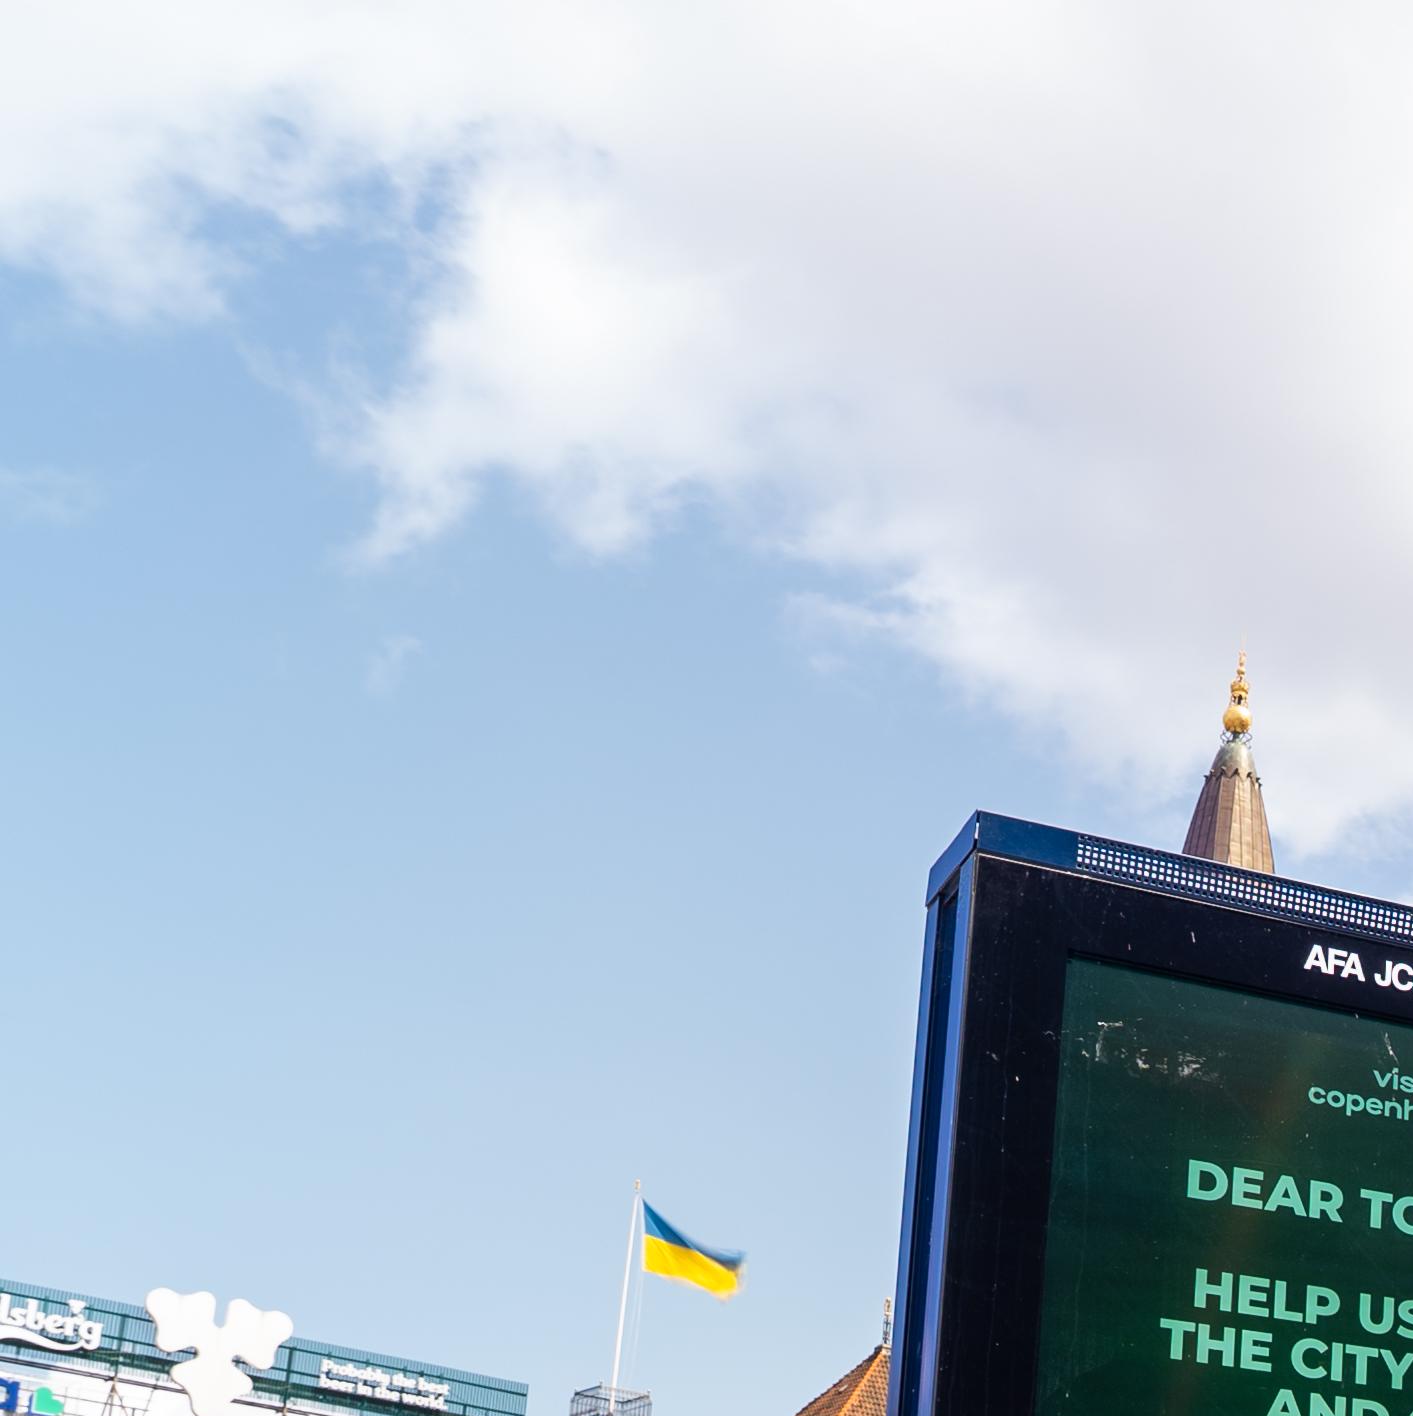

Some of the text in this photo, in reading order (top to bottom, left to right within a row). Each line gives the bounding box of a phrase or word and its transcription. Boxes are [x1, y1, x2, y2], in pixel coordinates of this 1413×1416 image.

[1304, 943, 1366, 982] AFA
[1187, 1158, 1343, 1223] DEAR
[1193, 1267, 1340, 1325] HELP
[1160, 1317, 1273, 1373] THE
[319, 1374, 356, 1392] beer
[356, 1382, 373, 1397] in
[374, 1385, 400, 1402] the
[321, 1359, 450, 1395] Probably the best
